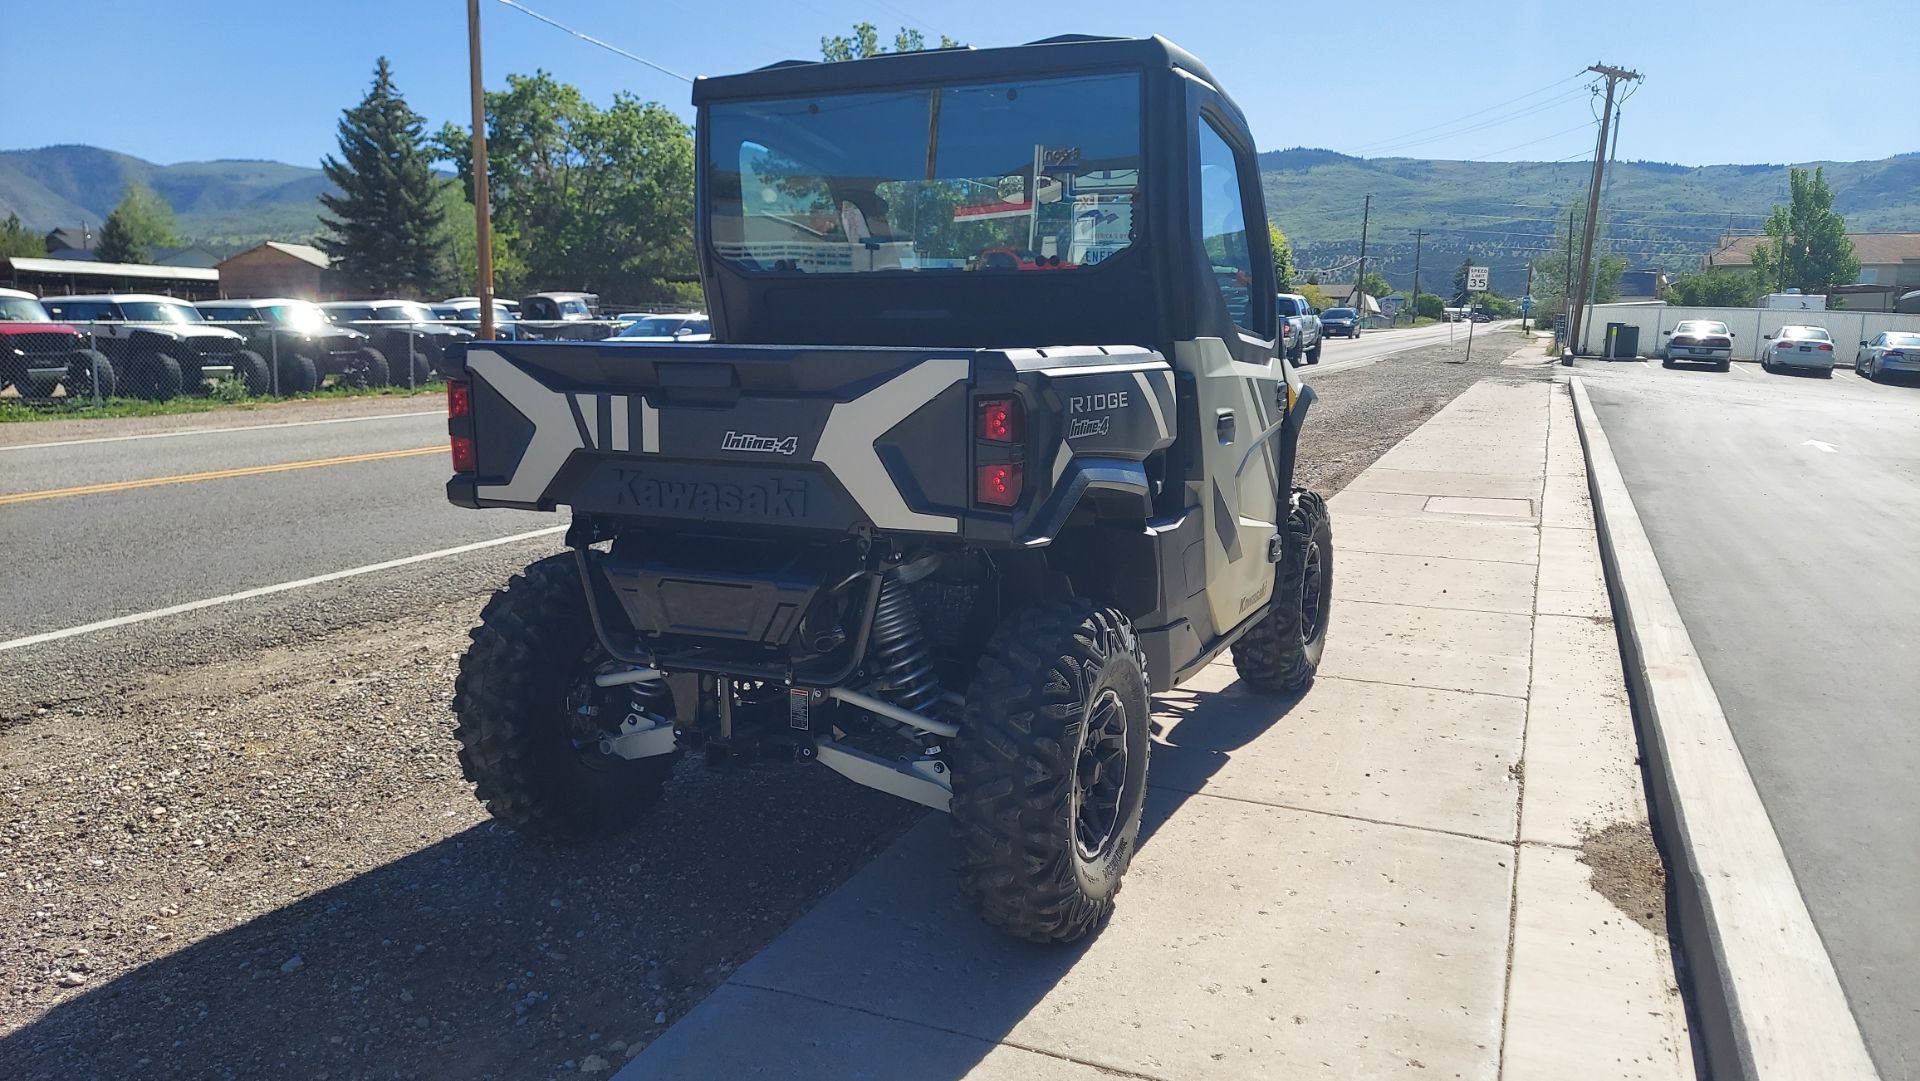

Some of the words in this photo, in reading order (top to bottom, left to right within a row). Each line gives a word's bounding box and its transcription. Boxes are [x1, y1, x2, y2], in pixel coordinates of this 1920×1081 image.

[1470, 279, 1486, 287] 35
[1070, 391, 1129, 414] RIDGE
[721, 431, 798, 455] Inline-4
[612, 467, 810, 518] Kawasaki
